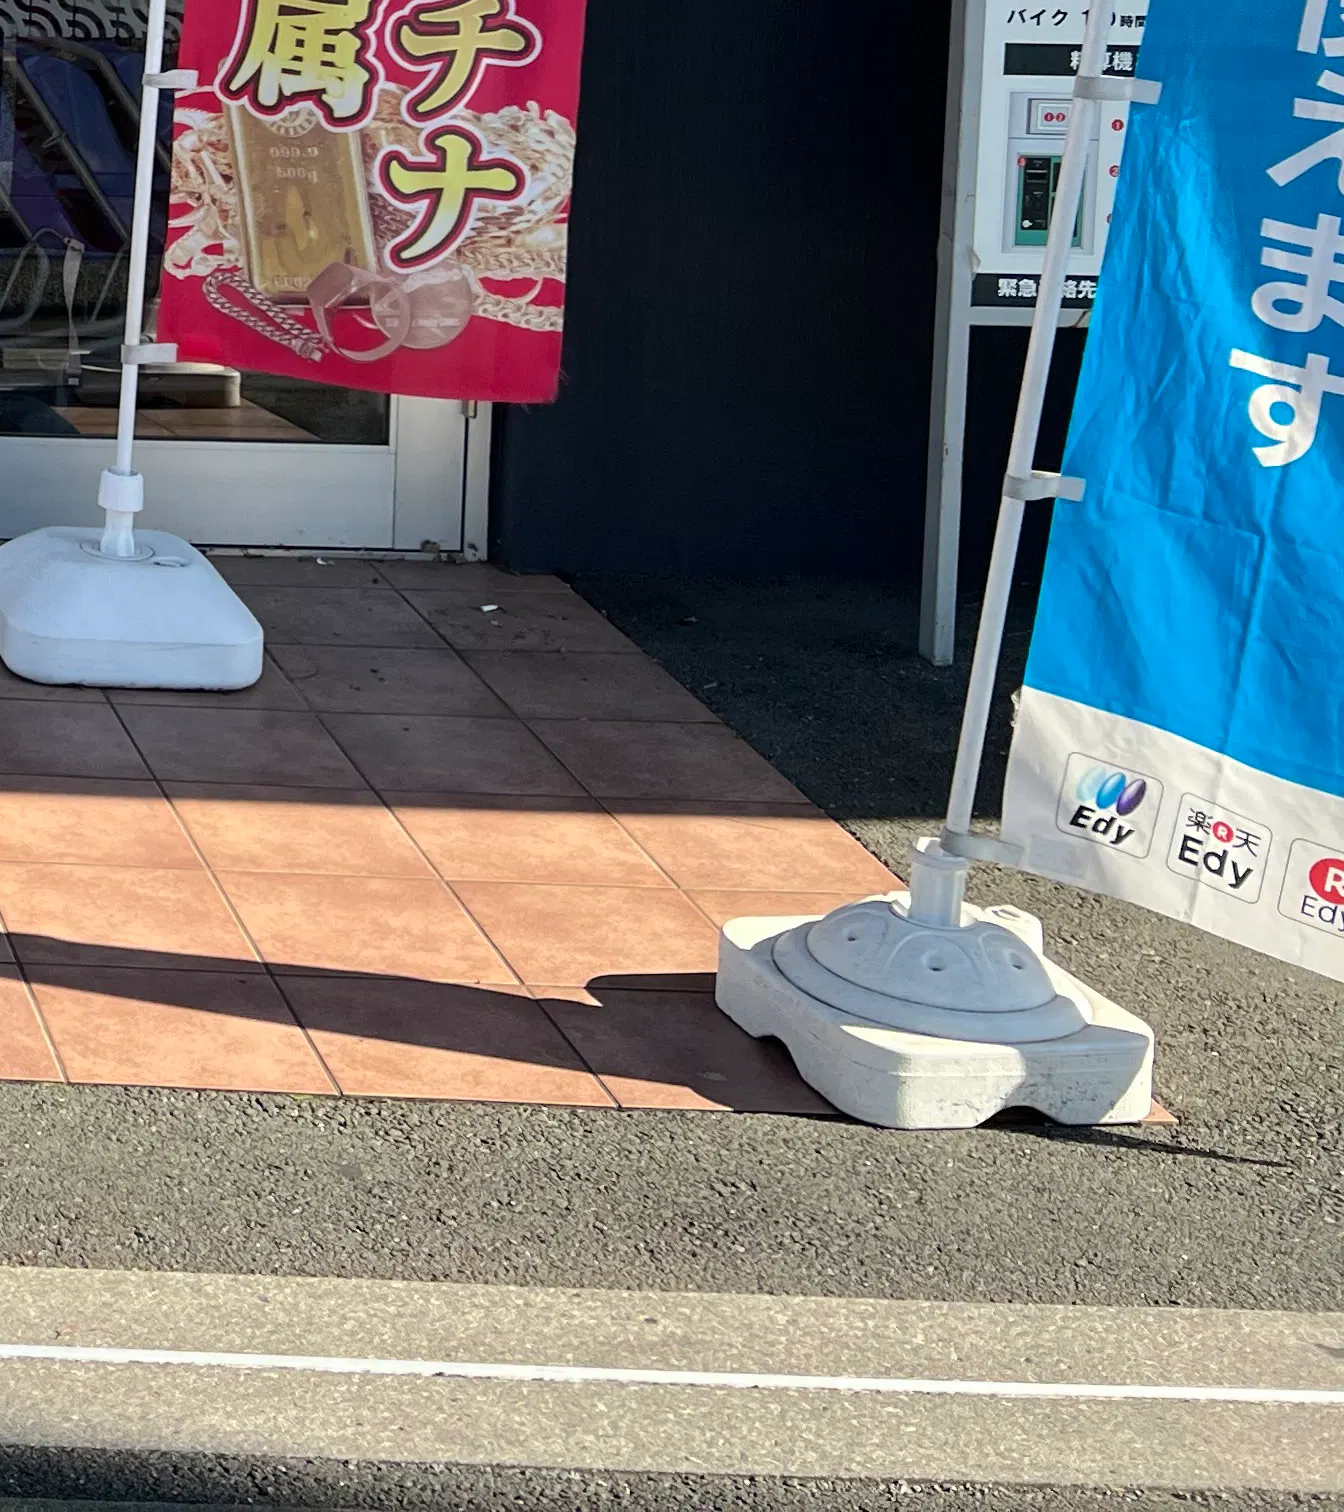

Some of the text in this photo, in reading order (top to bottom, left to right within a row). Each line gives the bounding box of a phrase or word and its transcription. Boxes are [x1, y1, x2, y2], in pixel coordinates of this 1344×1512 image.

[1007, 8, 1068, 26] バイク
[997, 278, 1097, 300] 緊急絡先
[1069, 804, 1136, 846] Edy
[1178, 834, 1254, 889] Edy
